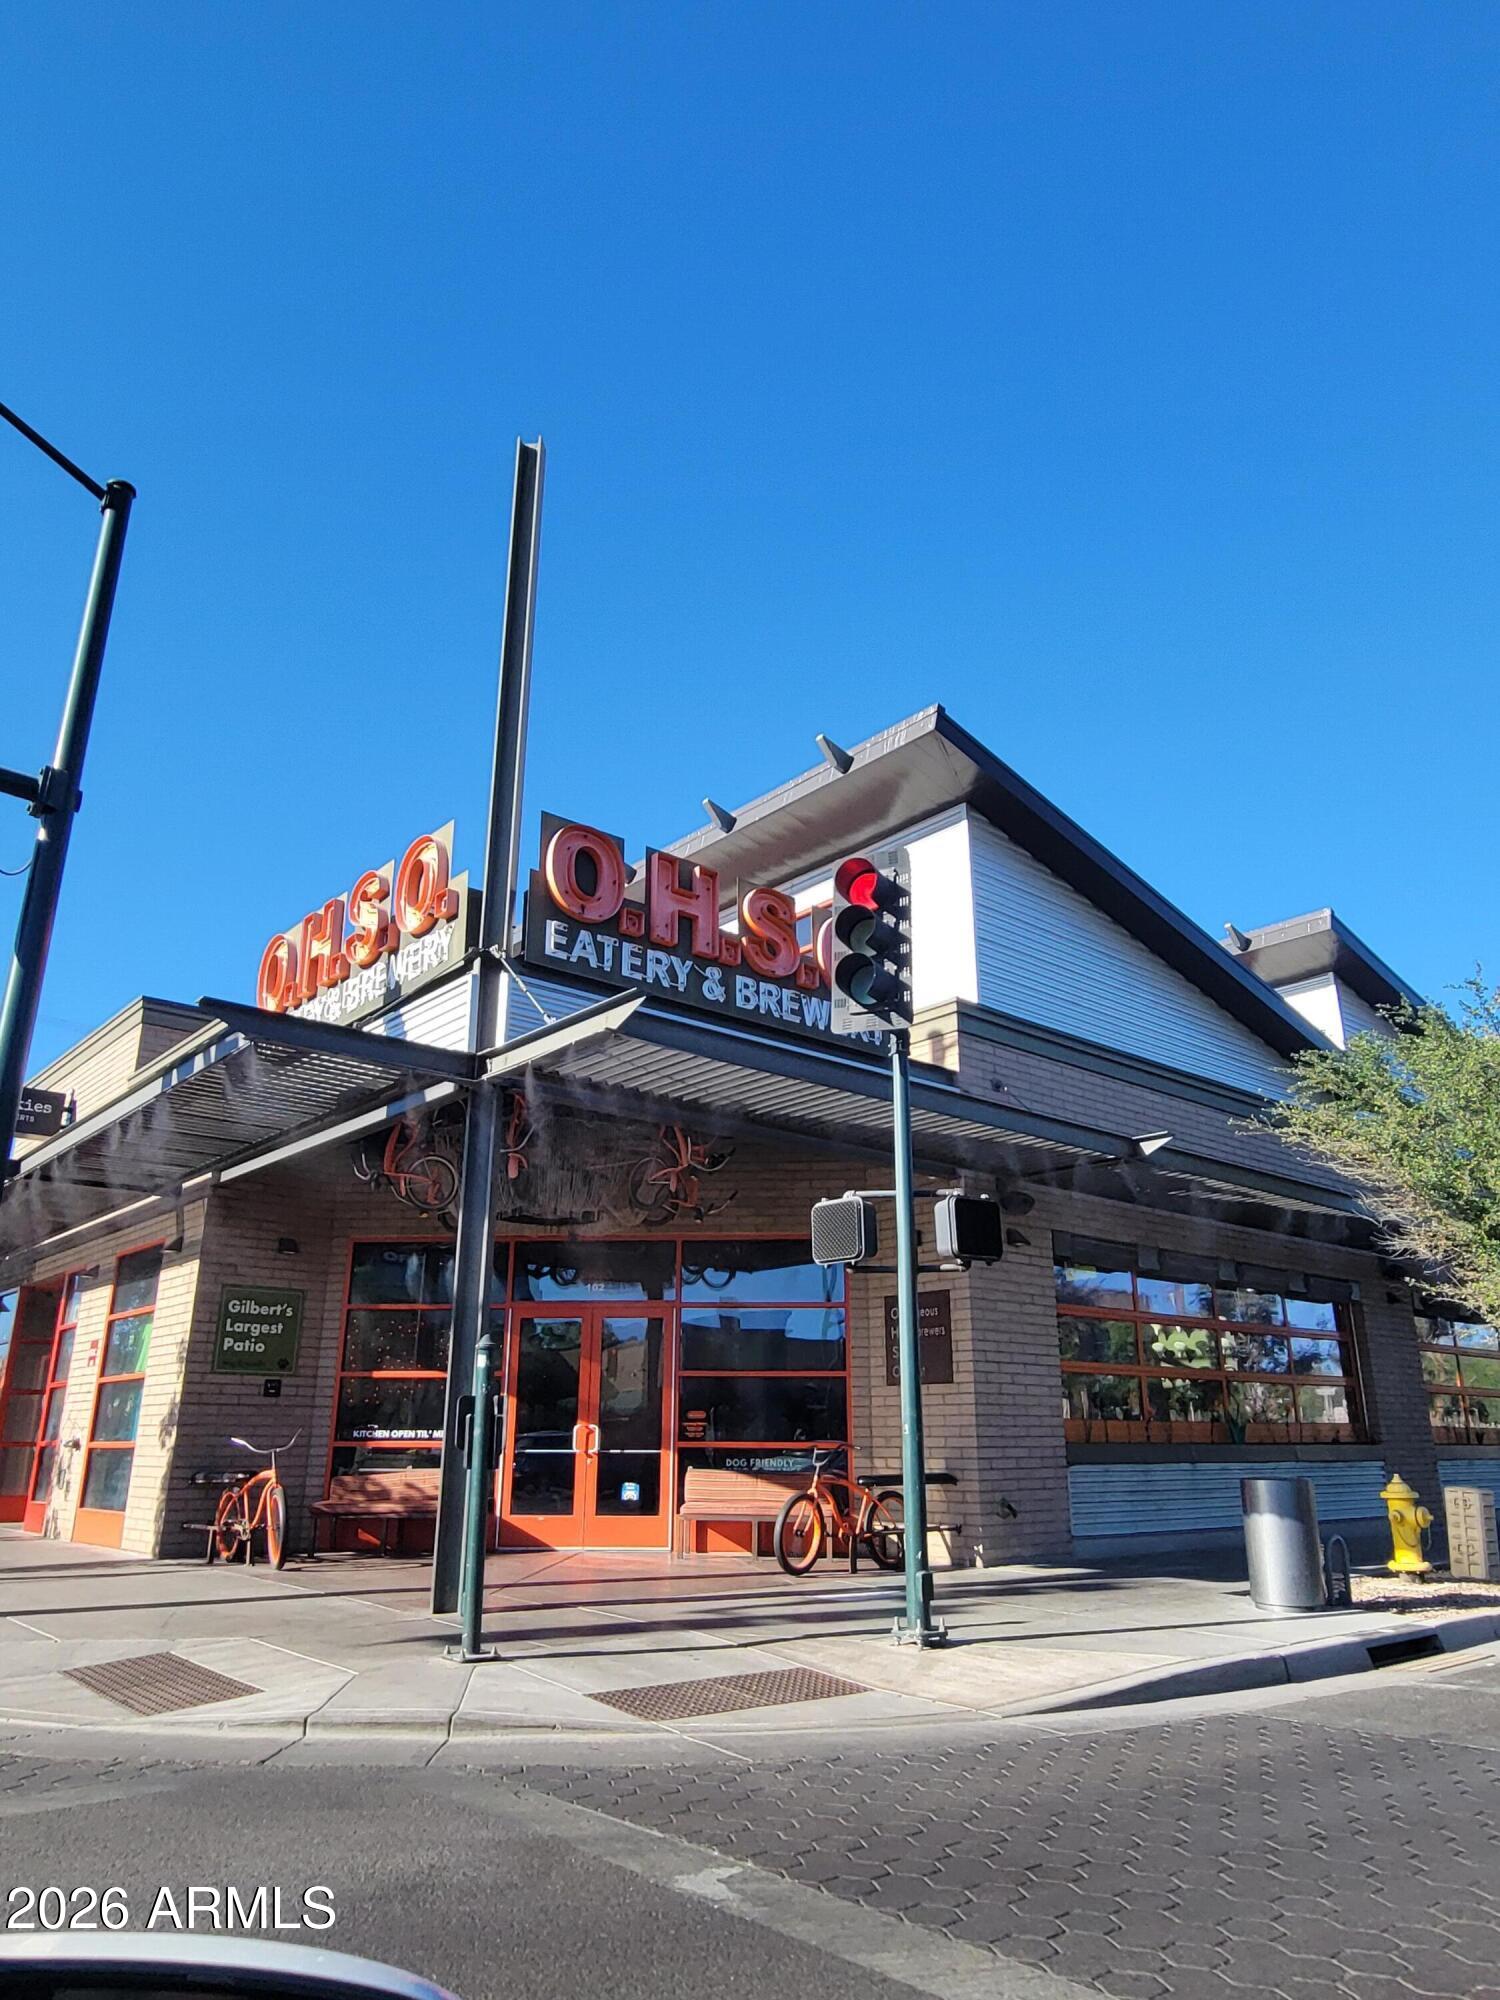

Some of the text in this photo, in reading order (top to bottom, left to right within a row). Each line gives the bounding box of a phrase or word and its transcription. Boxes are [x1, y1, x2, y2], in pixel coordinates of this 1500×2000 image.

[546, 824, 832, 990] O.H.S.
[544, 919, 693, 992] EATERY
[702, 966, 726, 1003] &
[228, 1300, 293, 1317] Gilbert's
[225, 1318, 284, 1337] Largest
[223, 1337, 265, 1353] Patio
[352, 1429, 390, 1438] KITCHEN
[391, 1429, 416, 1439] OPEN
[725, 1458, 795, 1468] DOG FRIENDLY
